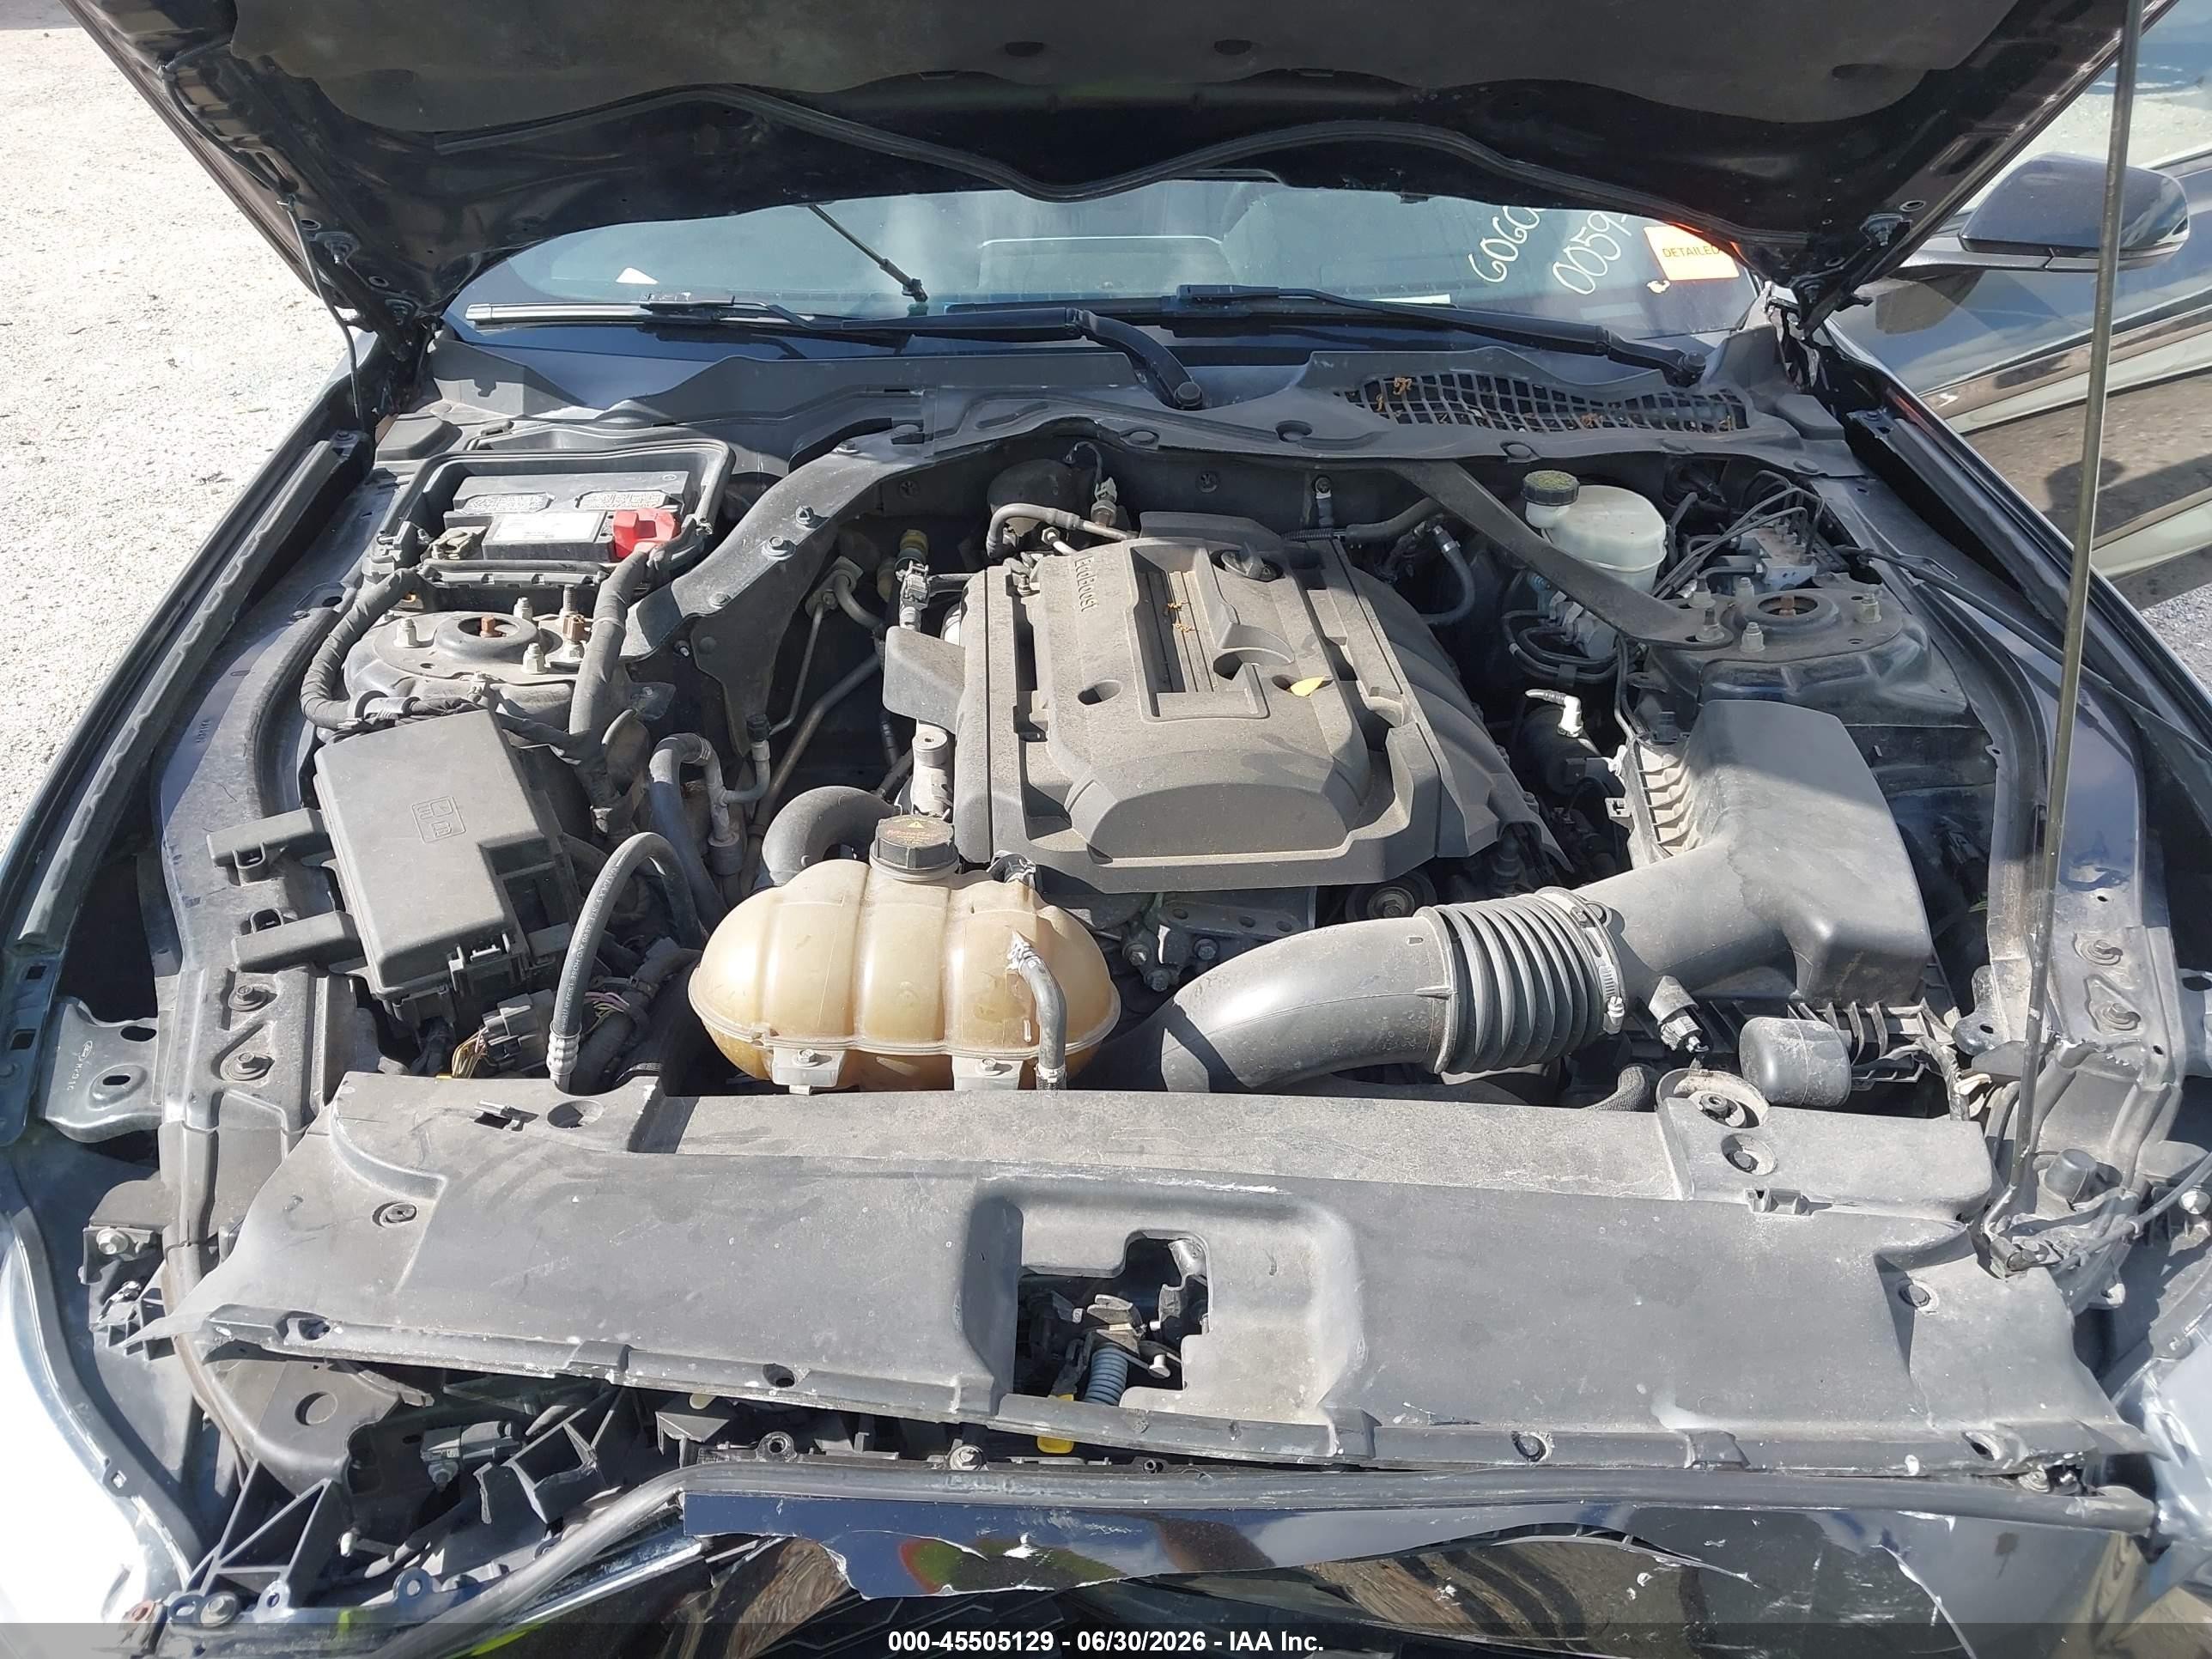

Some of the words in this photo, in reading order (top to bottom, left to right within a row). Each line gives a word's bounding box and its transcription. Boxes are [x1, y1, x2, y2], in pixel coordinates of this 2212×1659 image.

[1468, 206, 1546, 283] 6060
[1553, 211, 1632, 295] 0059
[1662, 245, 1721, 258] DETAILED
[1074, 556, 1099, 611] EcoBoost
[596, 867, 618, 903] GALAXY
[570, 959, 581, 981] HOSE
